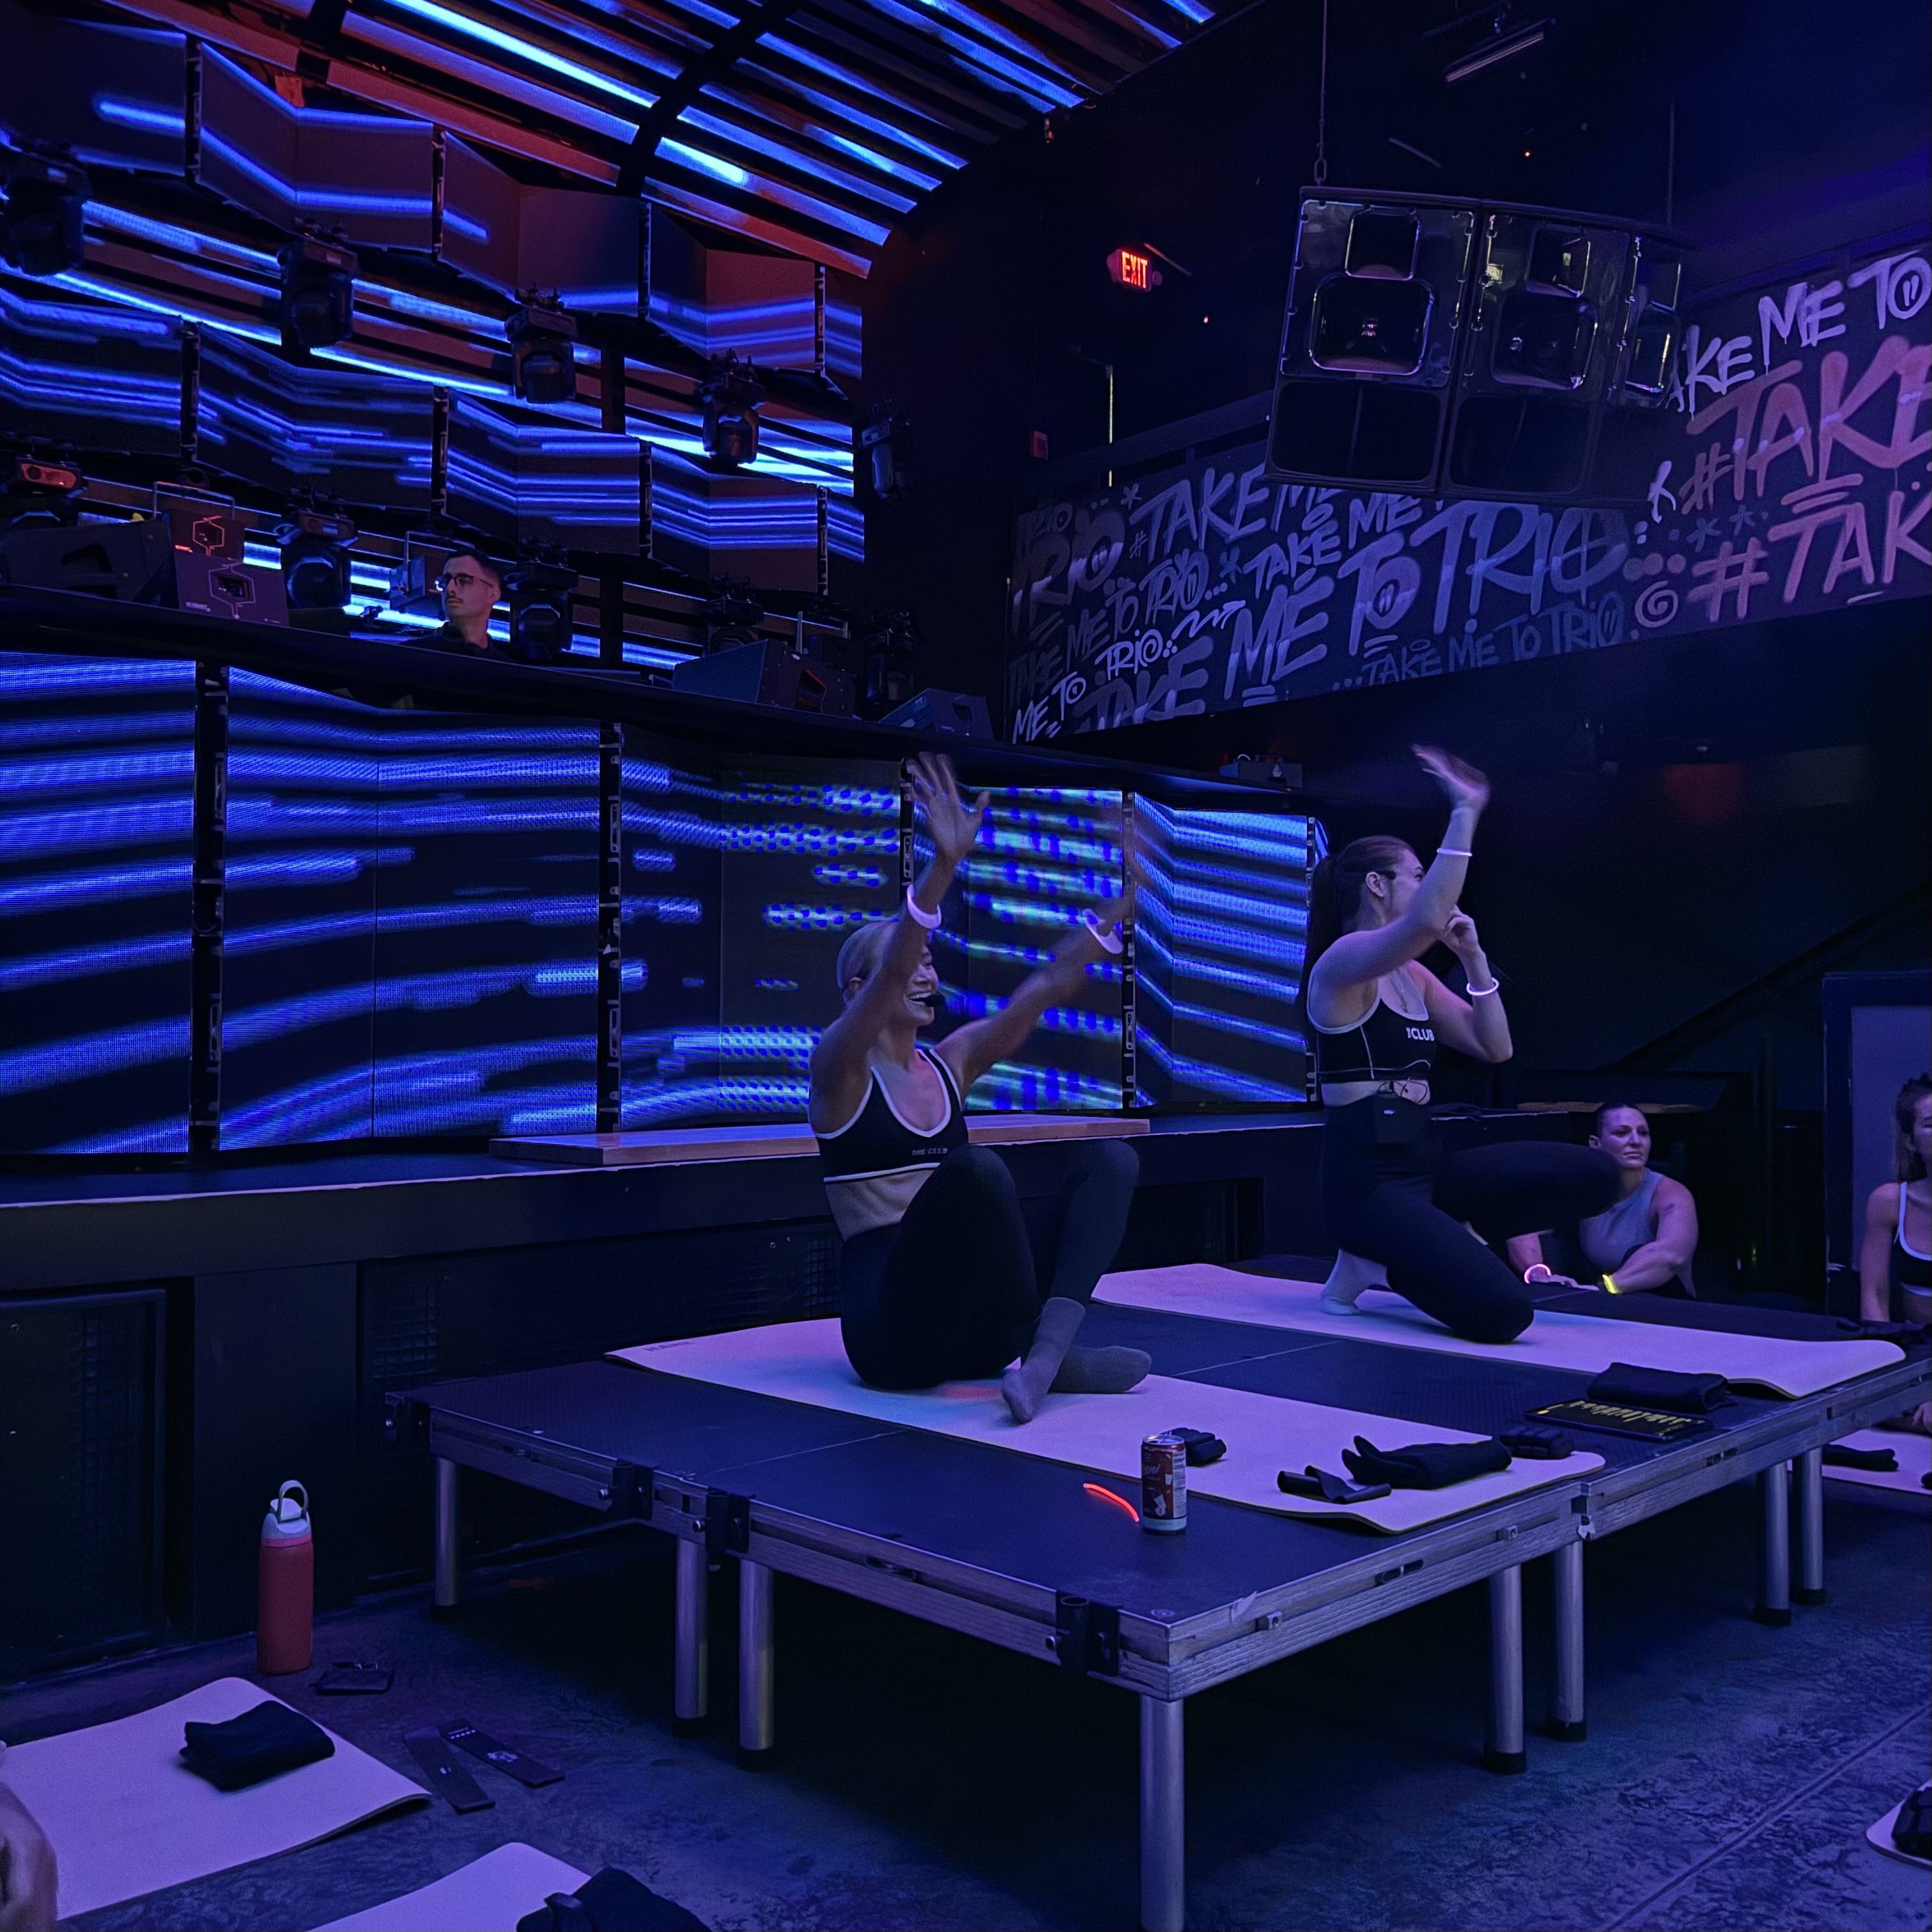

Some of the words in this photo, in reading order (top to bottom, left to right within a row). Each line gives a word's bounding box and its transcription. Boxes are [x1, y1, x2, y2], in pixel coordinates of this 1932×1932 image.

[1122, 251, 1148, 289] EXIT
[1758, 281, 1846, 376] ME
[1847, 249, 1932, 329] TO
[1242, 519, 1341, 600] TAKE
[1348, 491, 1423, 550] ME
[1066, 609, 1111, 674] ME
[1105, 578, 1140, 643] TO
[1074, 636, 1213, 732] TAKE
[1224, 575, 1334, 700] ME
[1338, 530, 1421, 656] TO
[1409, 500, 1630, 634] TRIO
[1448, 635, 1500, 673] ME
[1493, 614, 1542, 662] TO
[1535, 591, 1625, 654] TRIO
[1012, 693, 1051, 745] ME
[1051, 670, 1087, 722] TO
